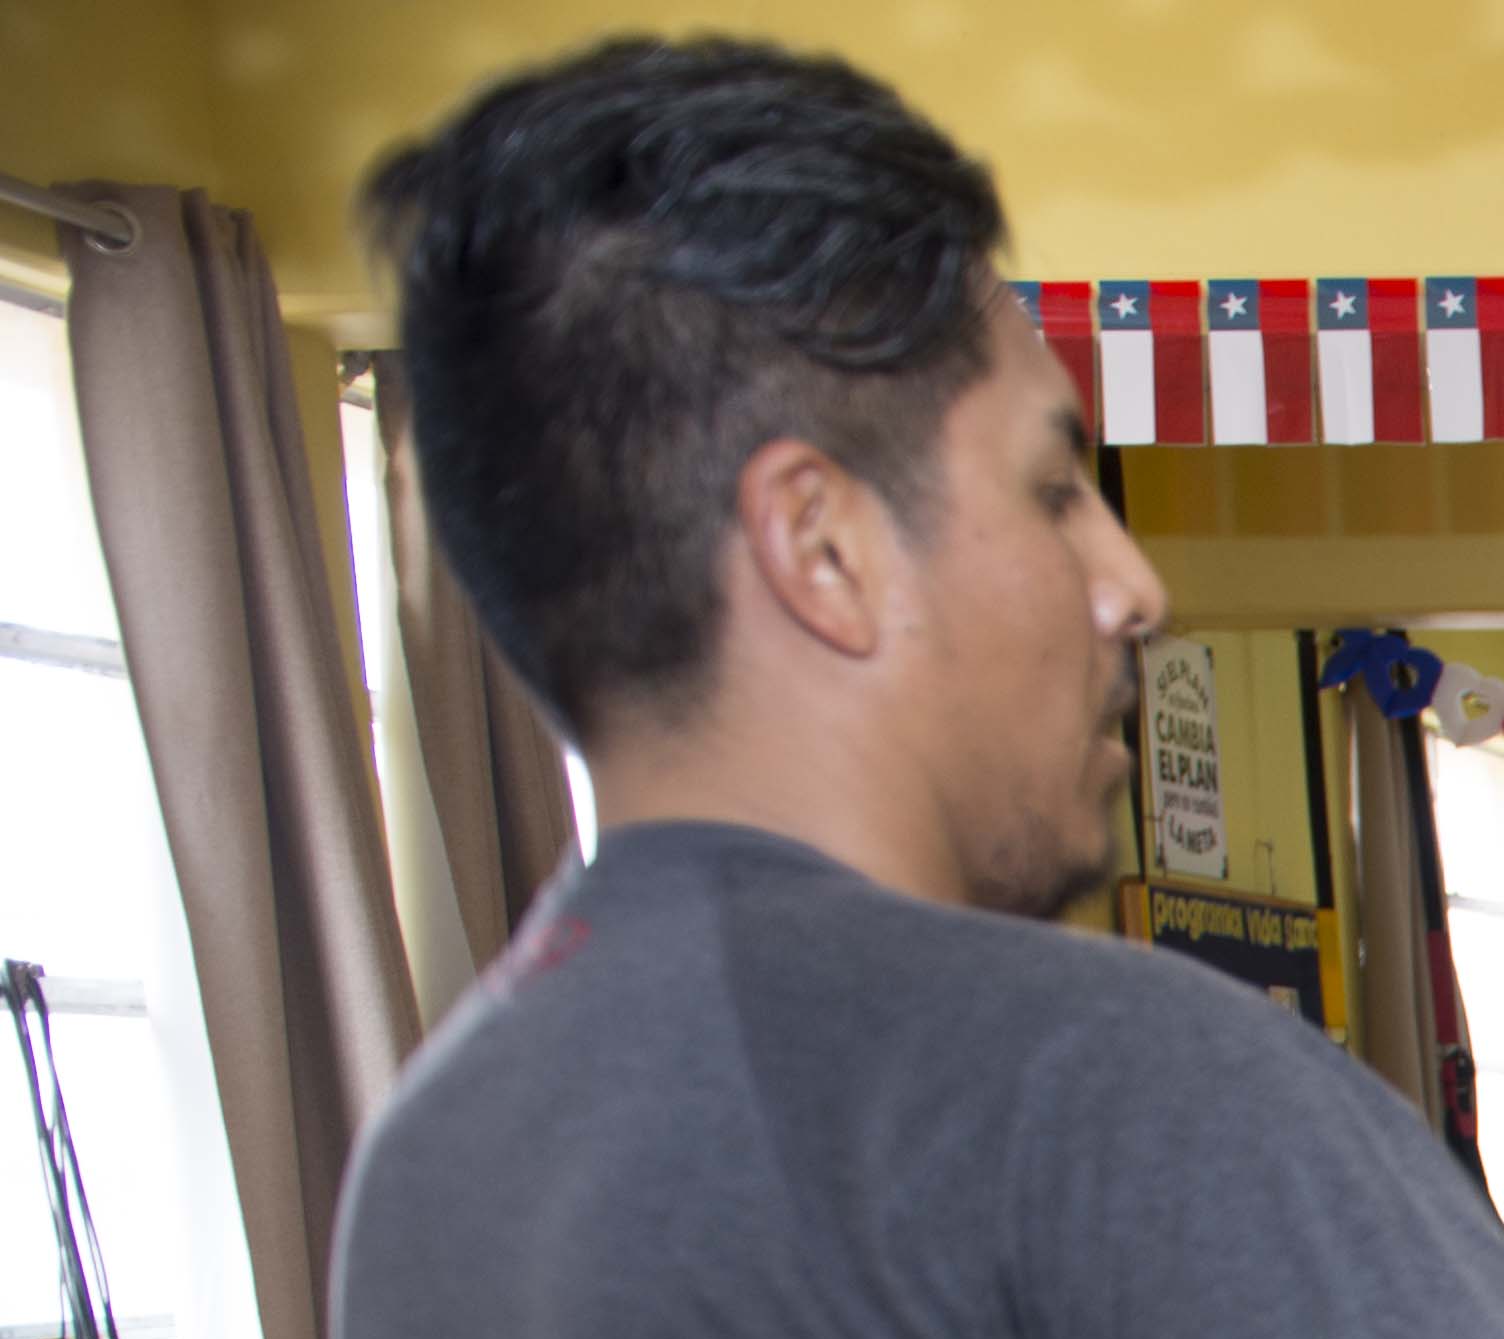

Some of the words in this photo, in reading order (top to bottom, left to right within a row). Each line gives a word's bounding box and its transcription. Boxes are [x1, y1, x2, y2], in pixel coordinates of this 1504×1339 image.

[1156, 710, 1217, 756] CAMBIA
[1159, 749, 1177, 783] EL
[1177, 752, 1219, 793] PLAN
